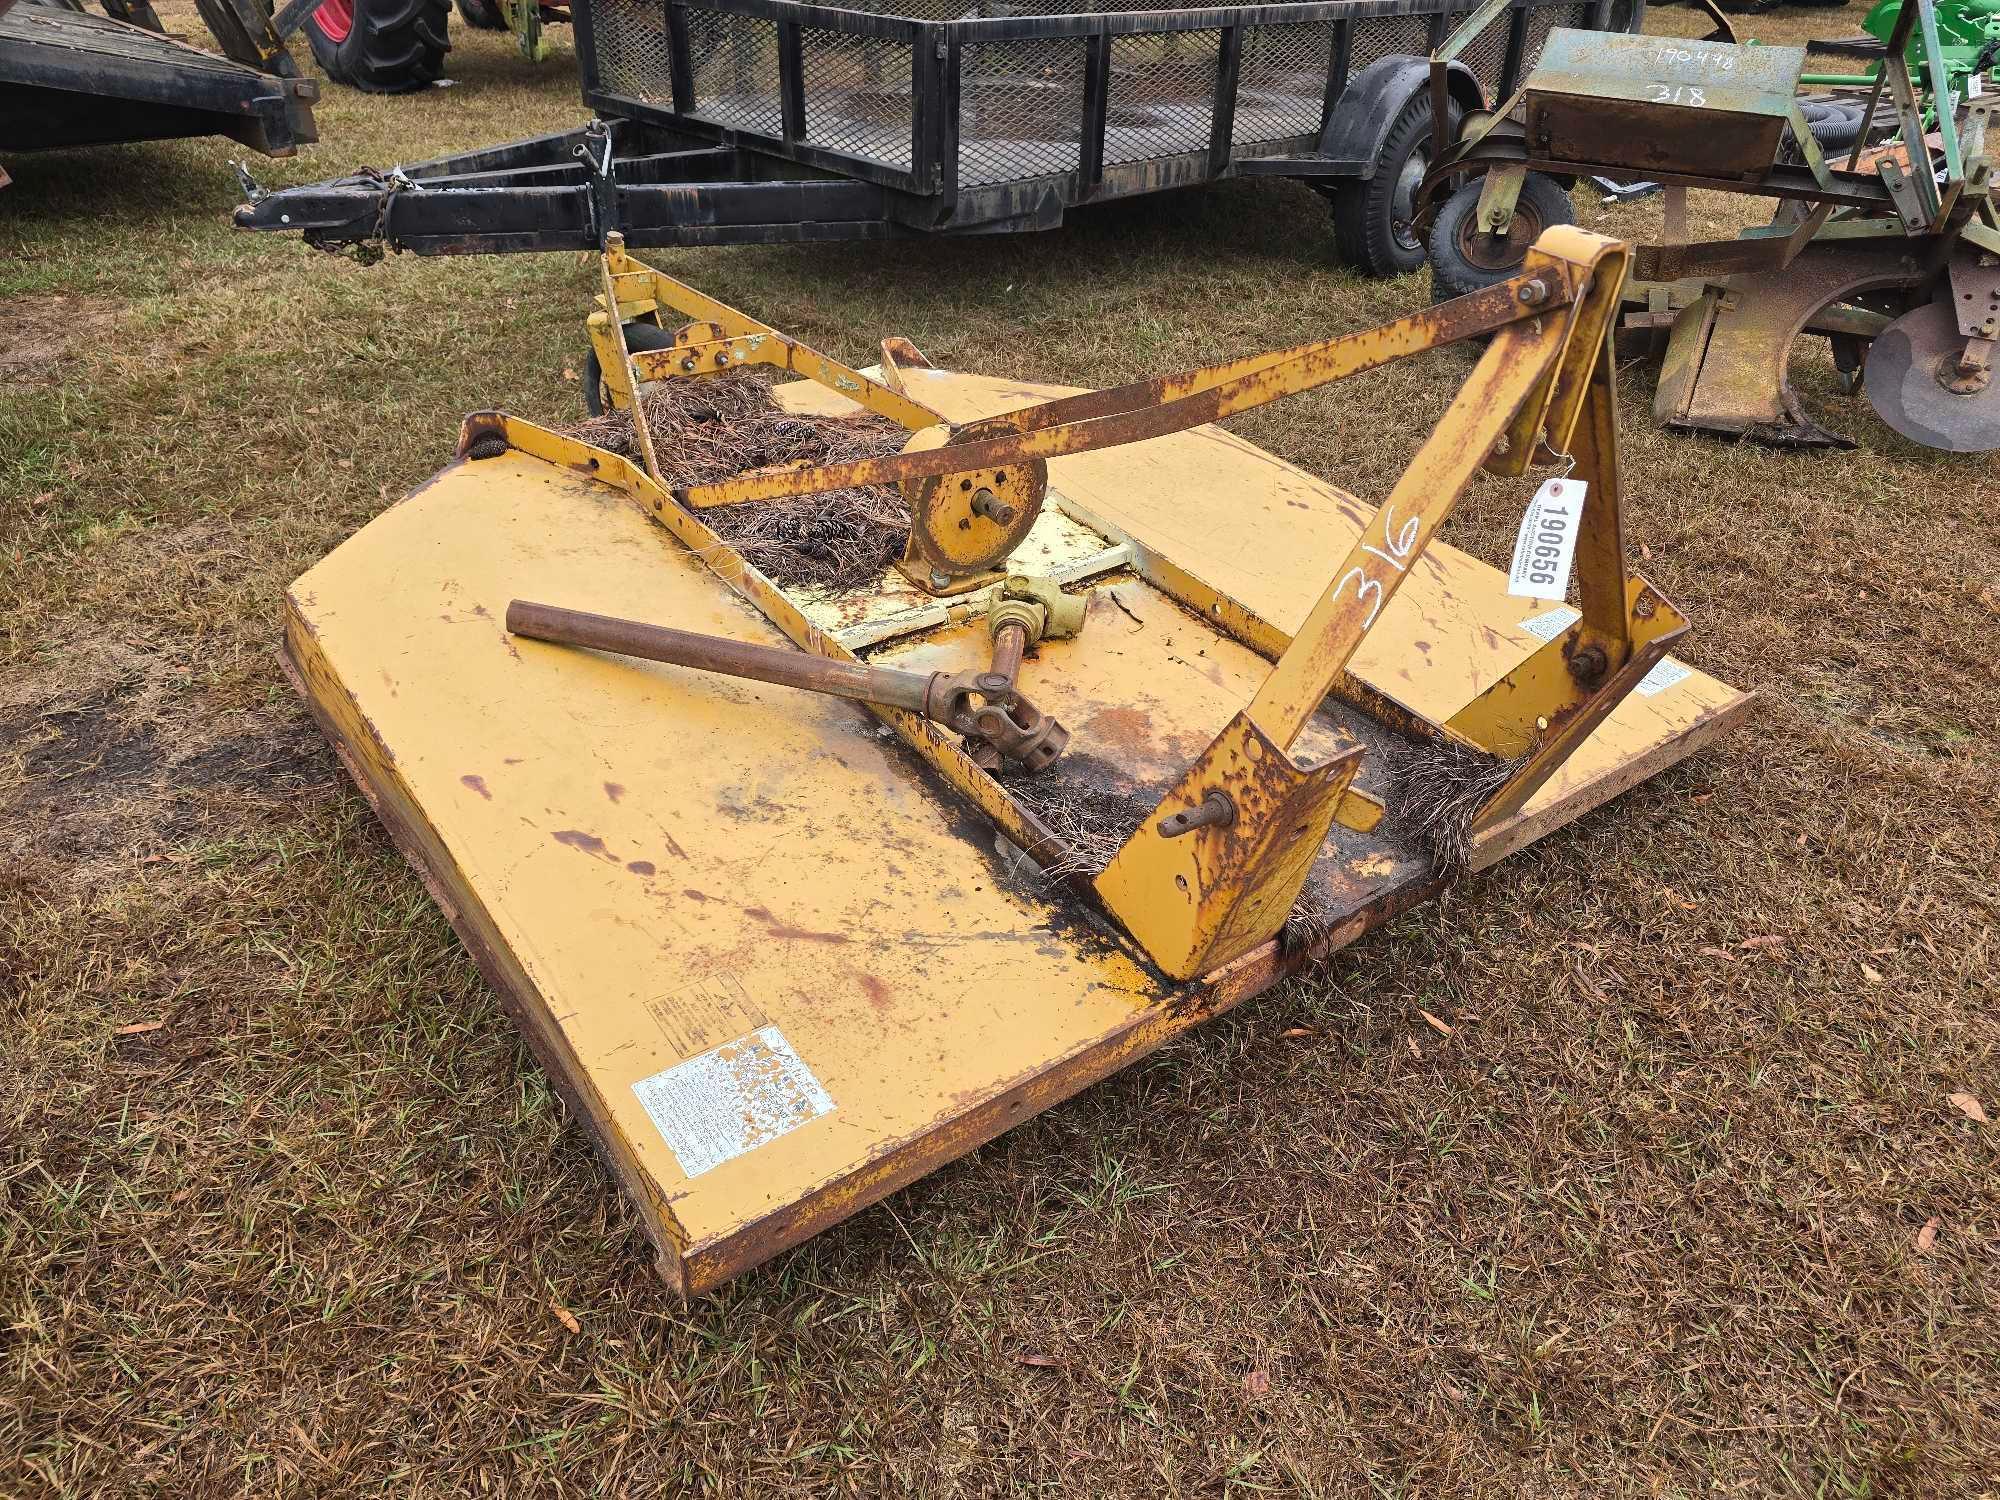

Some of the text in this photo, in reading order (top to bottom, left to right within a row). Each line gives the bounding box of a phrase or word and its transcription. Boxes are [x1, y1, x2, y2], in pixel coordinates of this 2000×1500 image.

[1646, 84, 1706, 106] 318
[1332, 504, 1419, 631] 316
[1529, 505, 1569, 585] 190656
